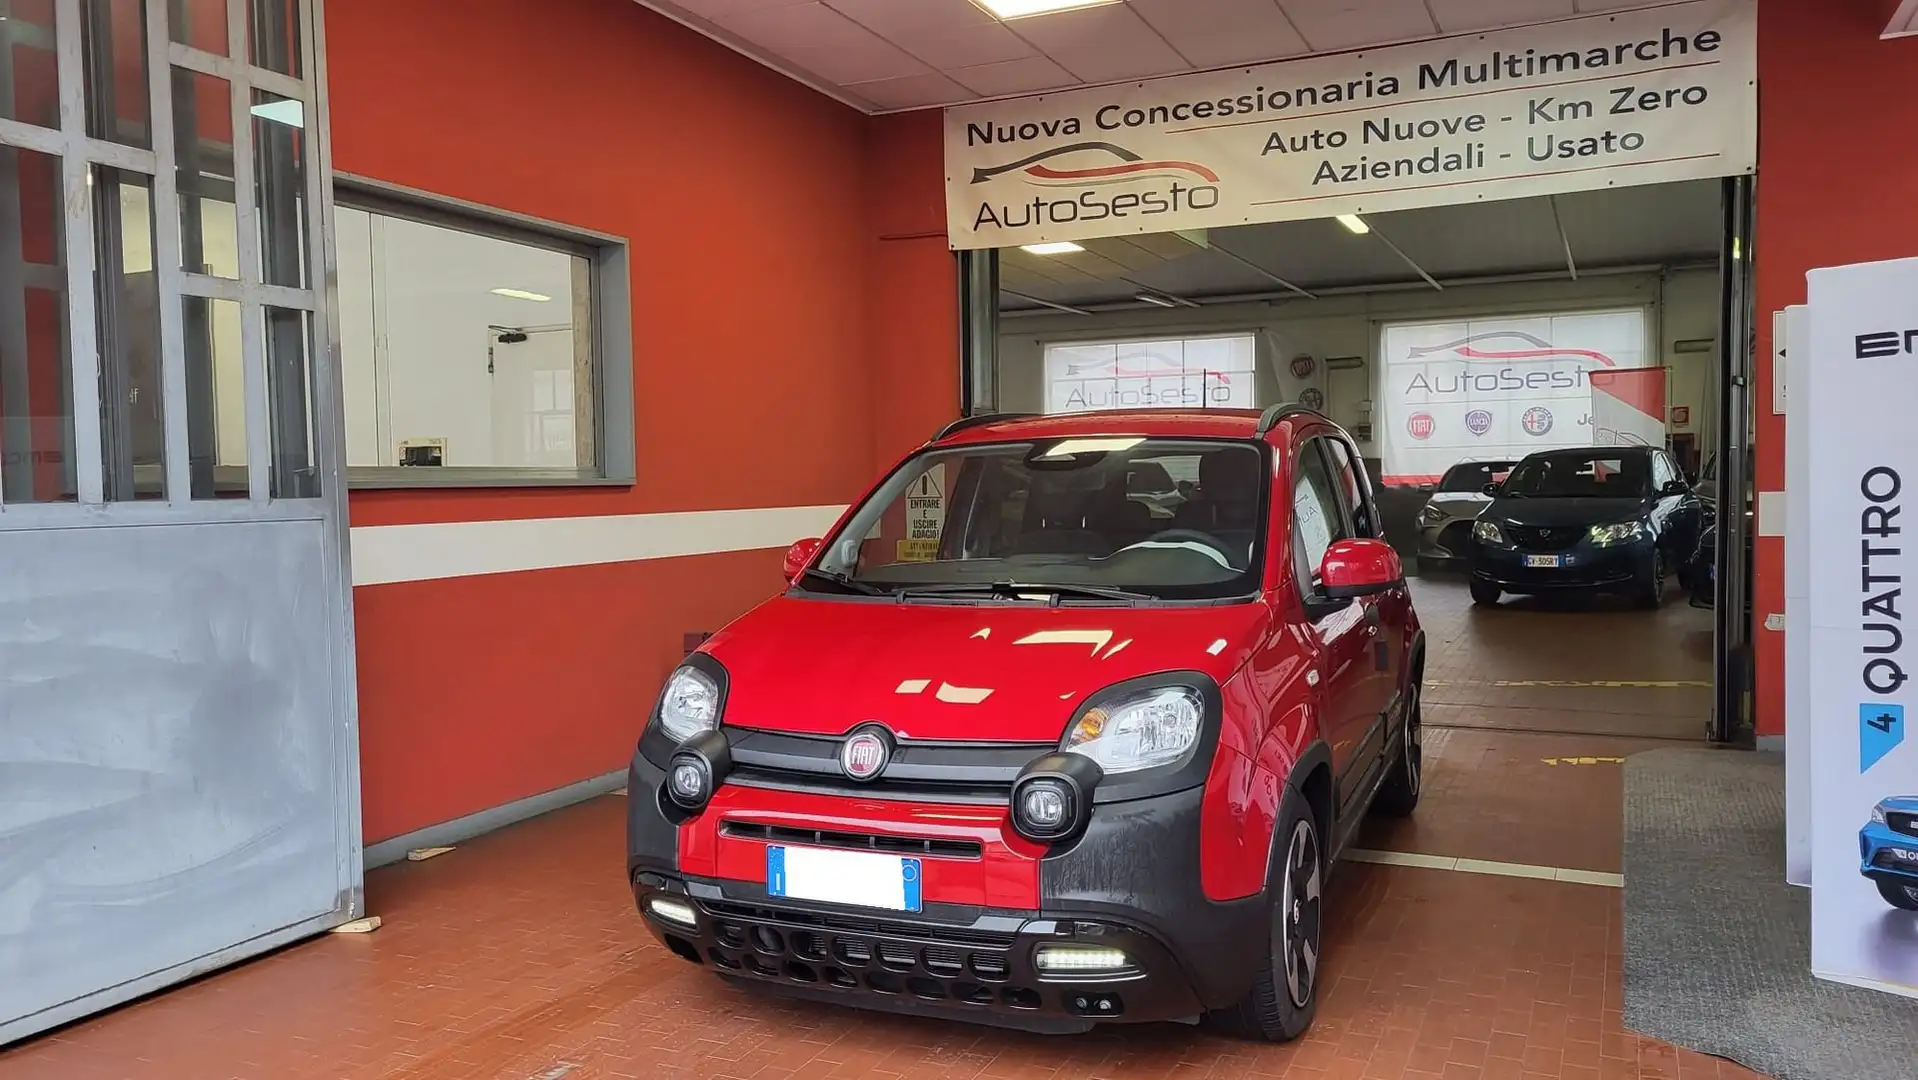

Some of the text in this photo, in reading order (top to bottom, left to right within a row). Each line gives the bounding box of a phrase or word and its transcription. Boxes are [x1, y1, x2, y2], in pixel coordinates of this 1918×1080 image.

[967, 27, 1722, 146] Nuova Concessionaria Multimarche
[1260, 128, 1348, 156] Auto
[1362, 114, 1486, 145] Nuove
[1528, 96, 1593, 125] Km
[1609, 85, 1708, 115] Zero
[1311, 142, 1485, 186] Aziendali
[1527, 130, 1645, 162] Usato
[973, 182, 1219, 232] AutoSesto
[910, 499, 940, 509] ENTRARE
[923, 509, 927, 518] E
[912, 529, 940, 539] ADAGIO!
[913, 519, 938, 529] USCIRE
[1861, 466, 1908, 733] 4 QUATTRO
[851, 744, 875, 765] FIAT
